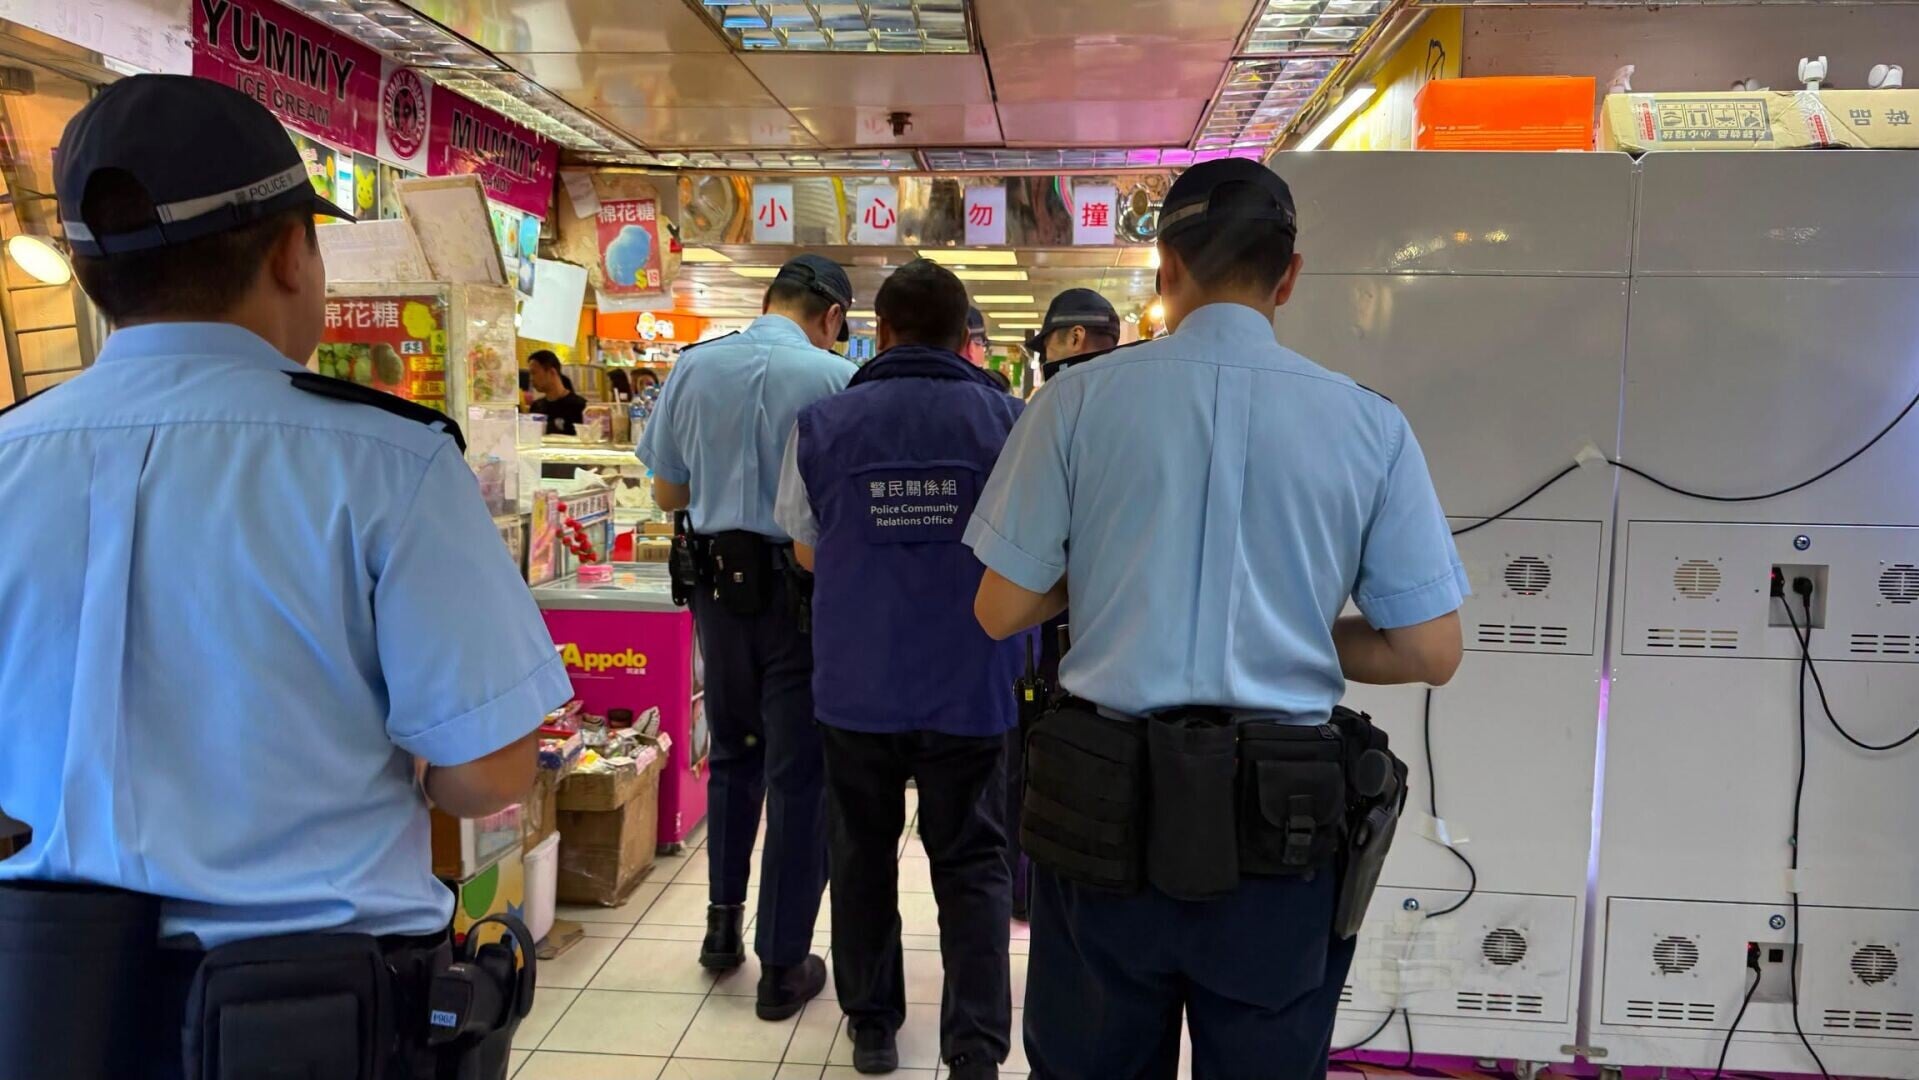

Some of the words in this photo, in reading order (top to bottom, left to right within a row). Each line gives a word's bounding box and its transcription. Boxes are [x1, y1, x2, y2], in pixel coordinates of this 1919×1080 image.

[200, 0, 356, 102] YUMMY
[236, 72, 266, 103] ICE
[273, 89, 329, 127] CREAM
[451, 109, 542, 182] MUMMY
[249, 175, 288, 200] POLICE
[598, 203, 656, 223] 棉花糖
[870, 480, 957, 498] 警民關係組
[870, 505, 899, 514] Police
[901, 503, 959, 514] Community
[876, 517, 921, 526] Relations
[923, 515, 953, 525] Office
[563, 643, 647, 672] Appolo
